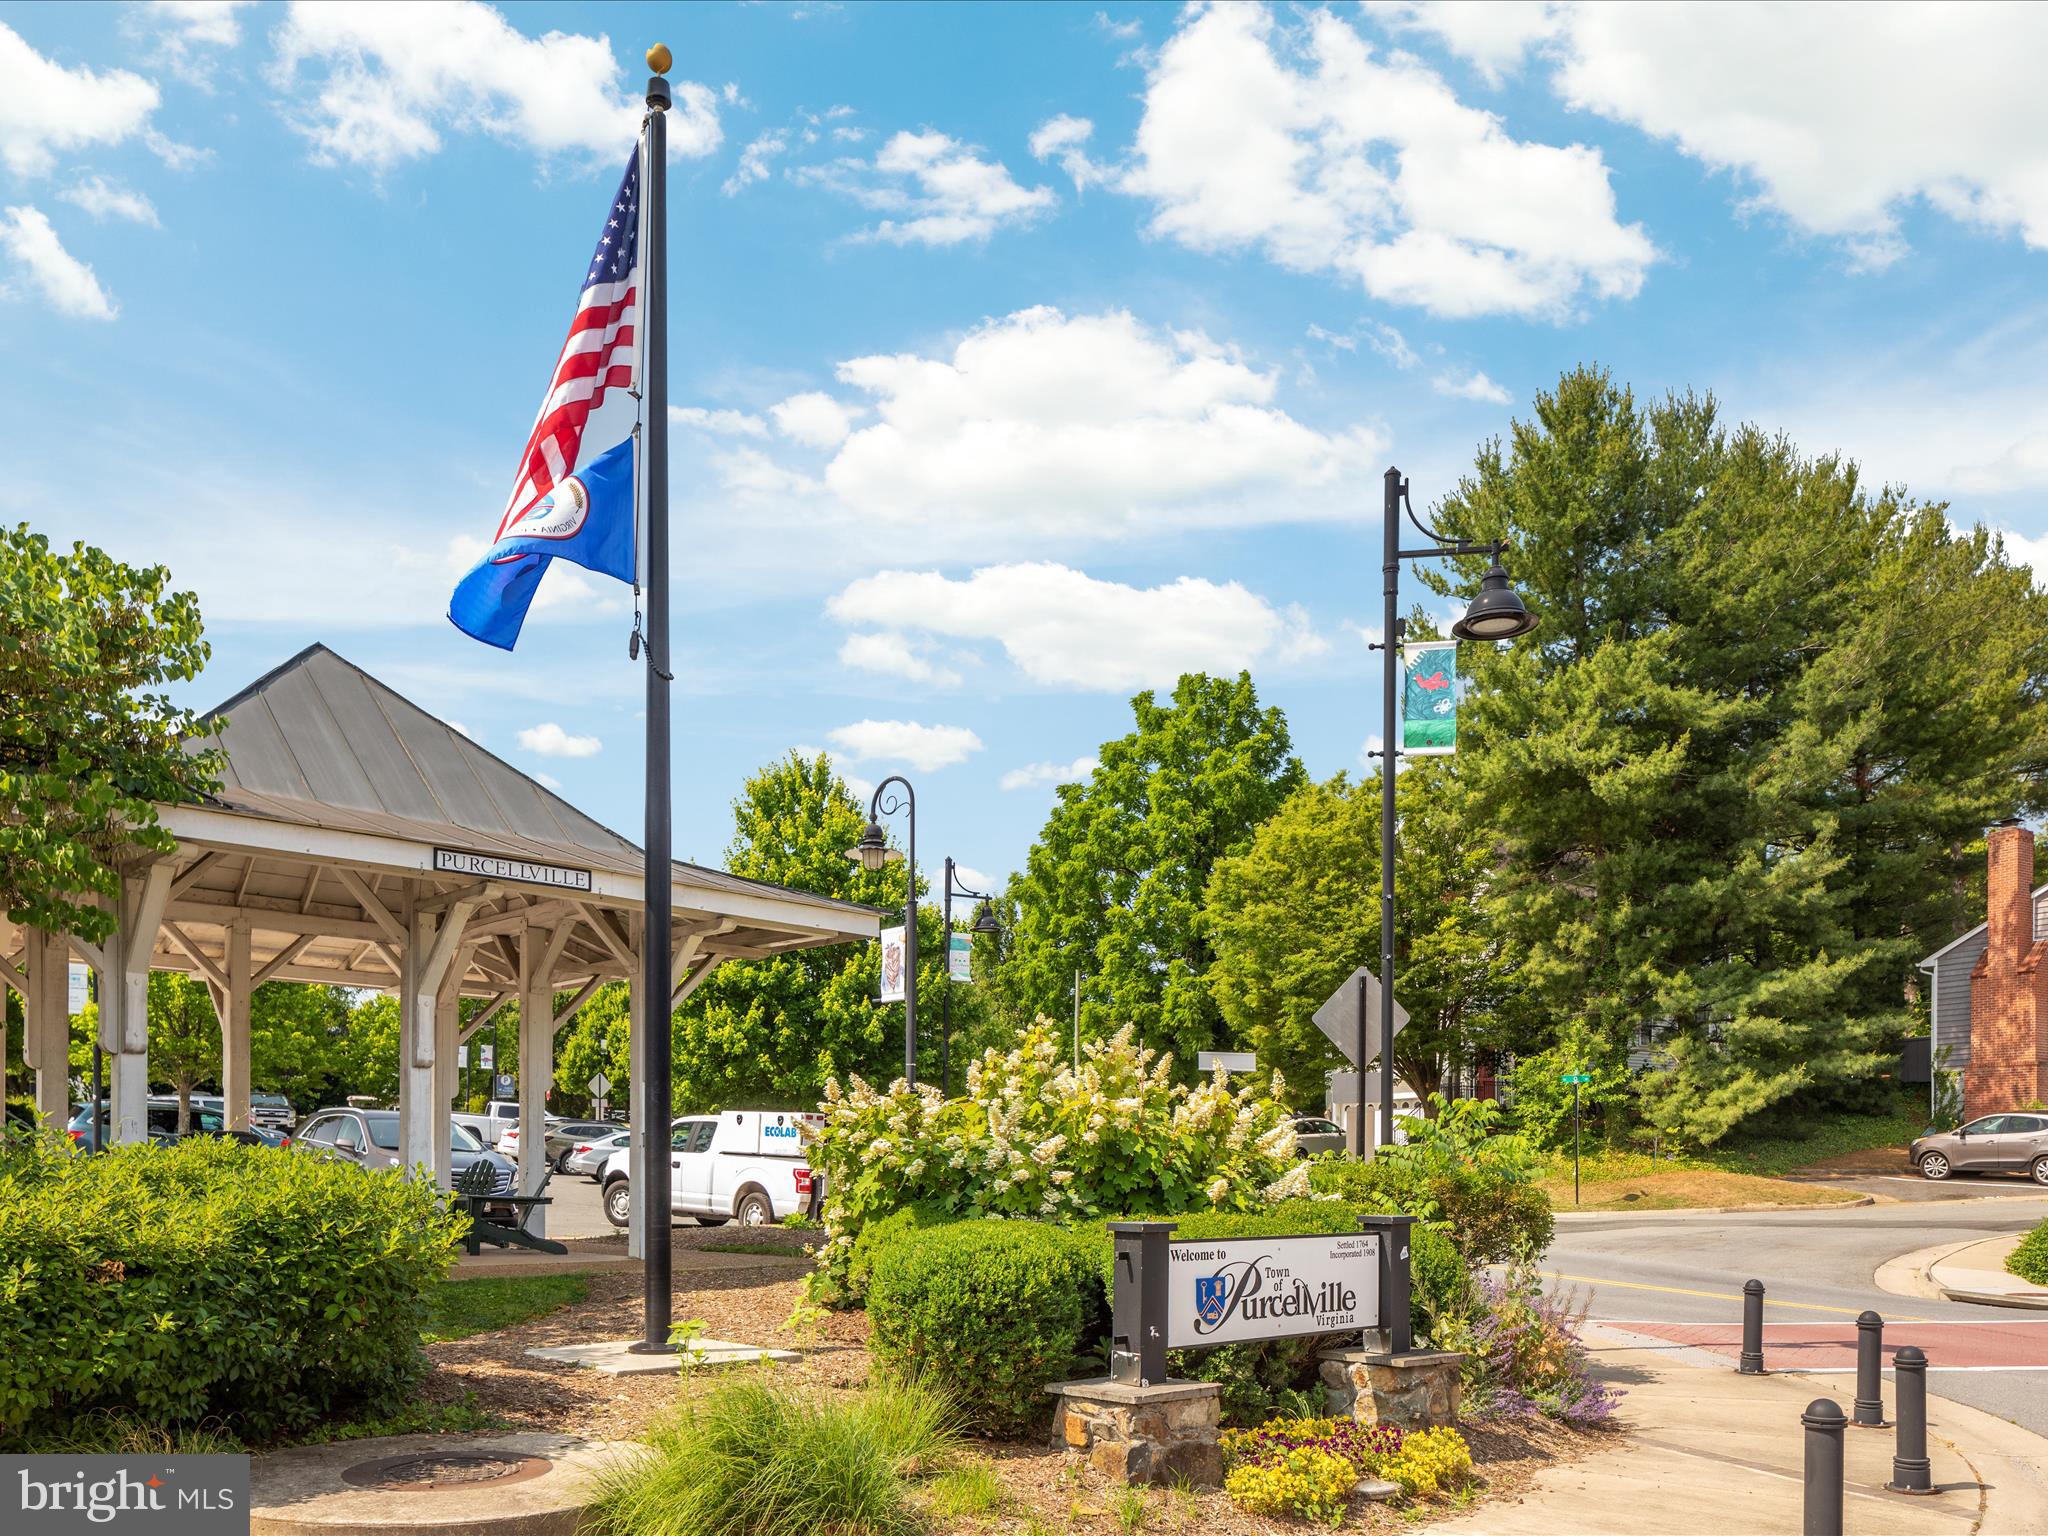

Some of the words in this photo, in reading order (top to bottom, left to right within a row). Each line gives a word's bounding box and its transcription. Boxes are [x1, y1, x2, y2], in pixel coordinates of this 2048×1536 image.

[441, 852, 585, 887] PURCELLVILLE
[764, 1126, 797, 1138] ECOLAB
[1336, 1241, 1355, 1250] Settled
[1356, 1240, 1369, 1249] 1764
[1170, 1249, 1215, 1262] Welcome
[1217, 1248, 1226, 1260] to
[1329, 1249, 1362, 1260] Incorporated
[1363, 1249, 1376, 1258] 1908
[1265, 1267, 1290, 1279] Town
[1273, 1279, 1283, 1292] of
[1316, 1312, 1354, 1328] Virginia
